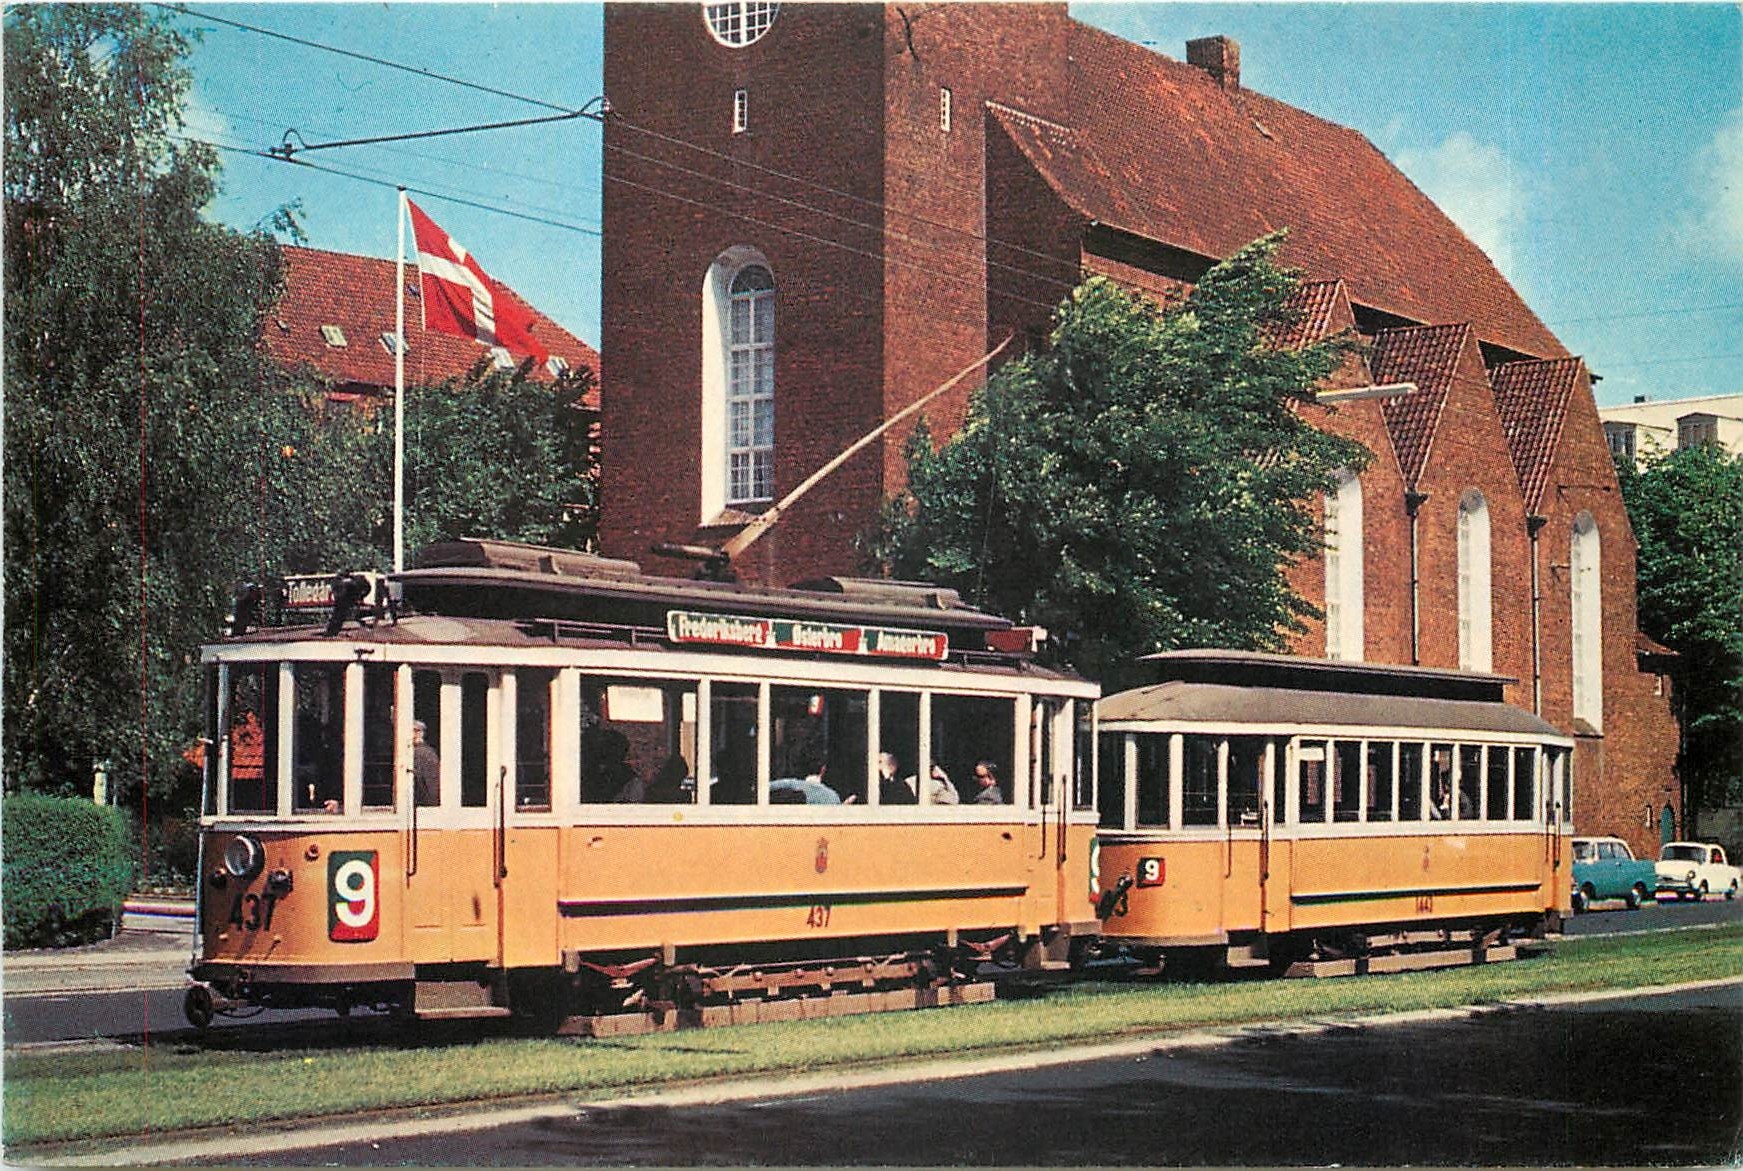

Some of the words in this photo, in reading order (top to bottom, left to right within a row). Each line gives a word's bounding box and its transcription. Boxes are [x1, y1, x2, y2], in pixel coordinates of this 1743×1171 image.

[1145, 860, 1160, 881] 9
[335, 859, 375, 928] 9
[806, 903, 832, 928] 437
